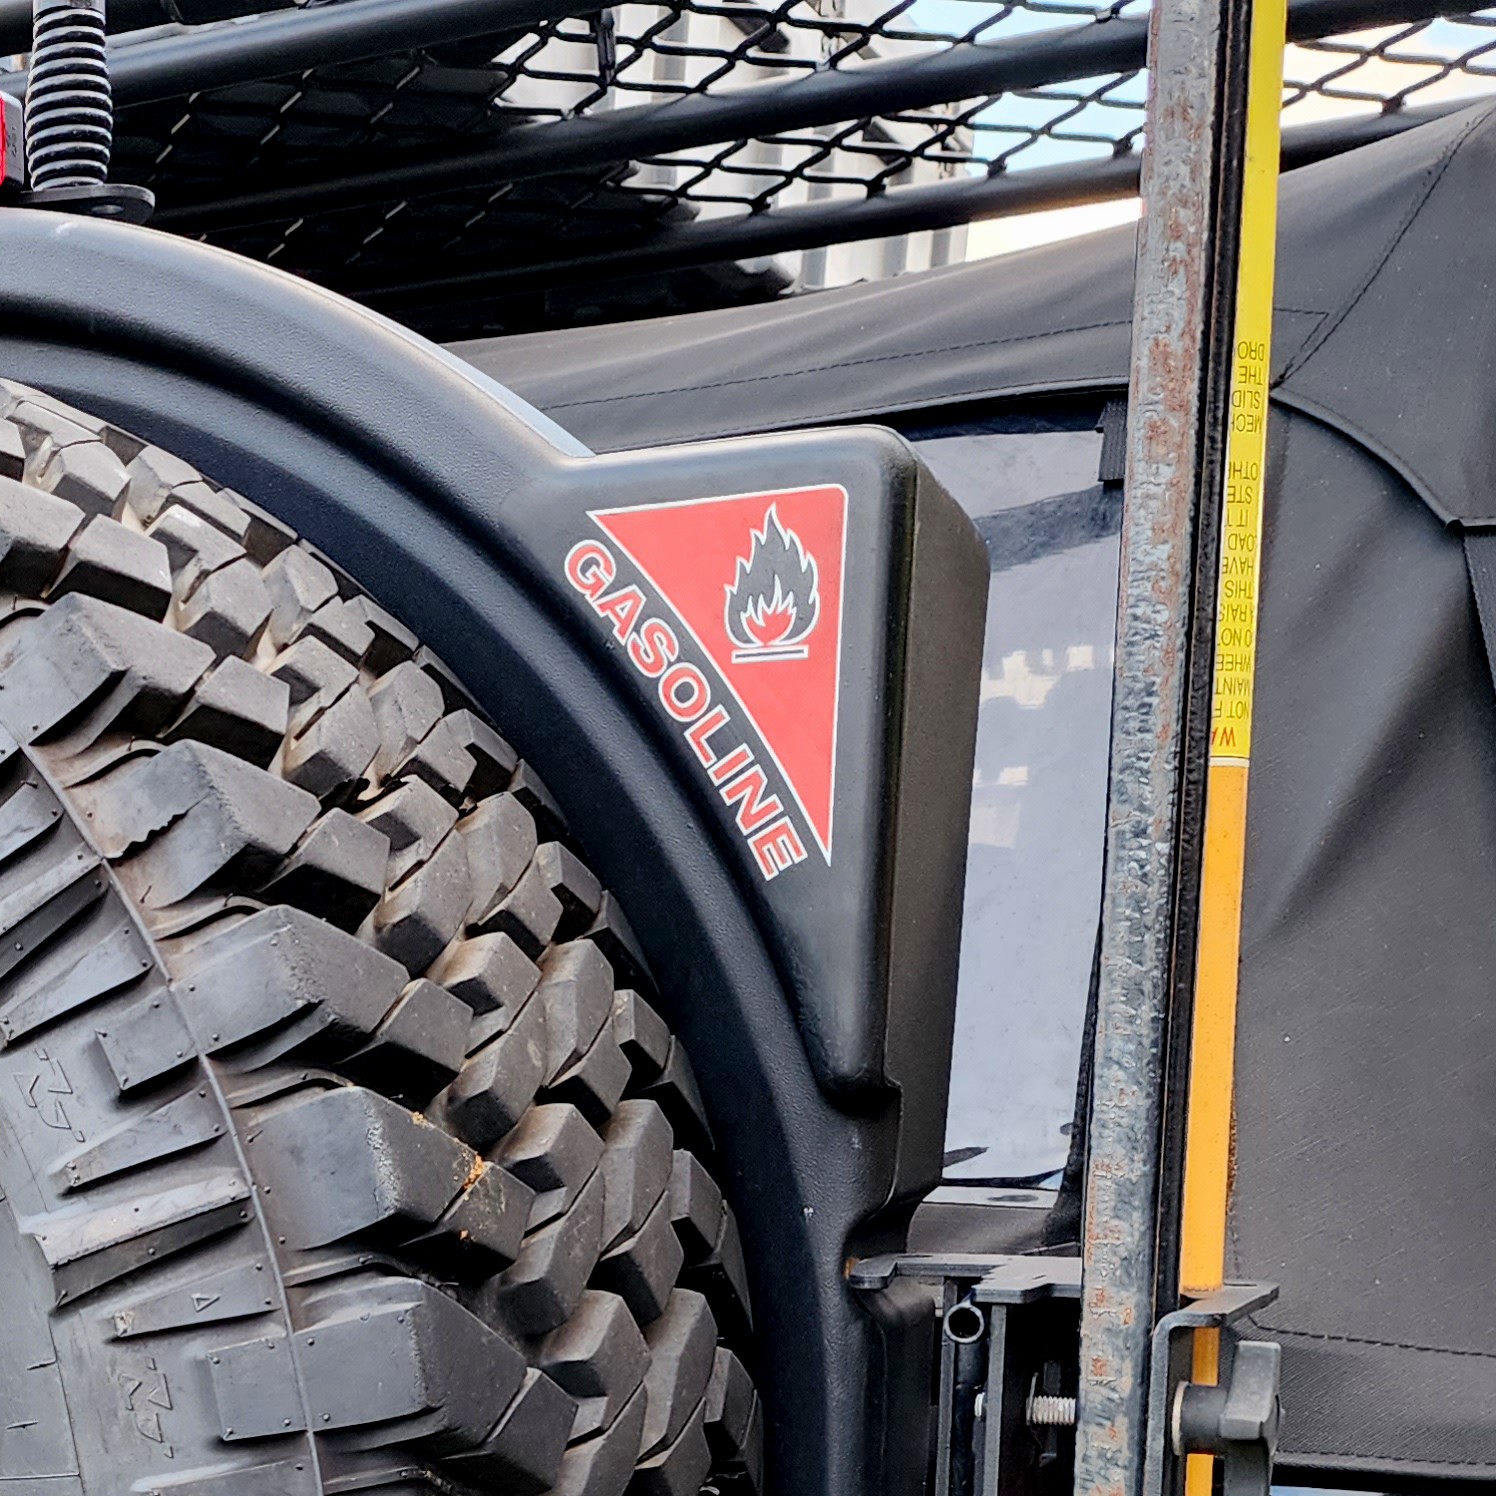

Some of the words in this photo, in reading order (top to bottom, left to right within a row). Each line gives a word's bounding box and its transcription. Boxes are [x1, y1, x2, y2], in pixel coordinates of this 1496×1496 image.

[1238, 366, 1263, 386] THE
[1222, 556, 1254, 577] HAVE
[1225, 579, 1254, 600] THIS
[563, 539, 808, 882] GASOLINE
